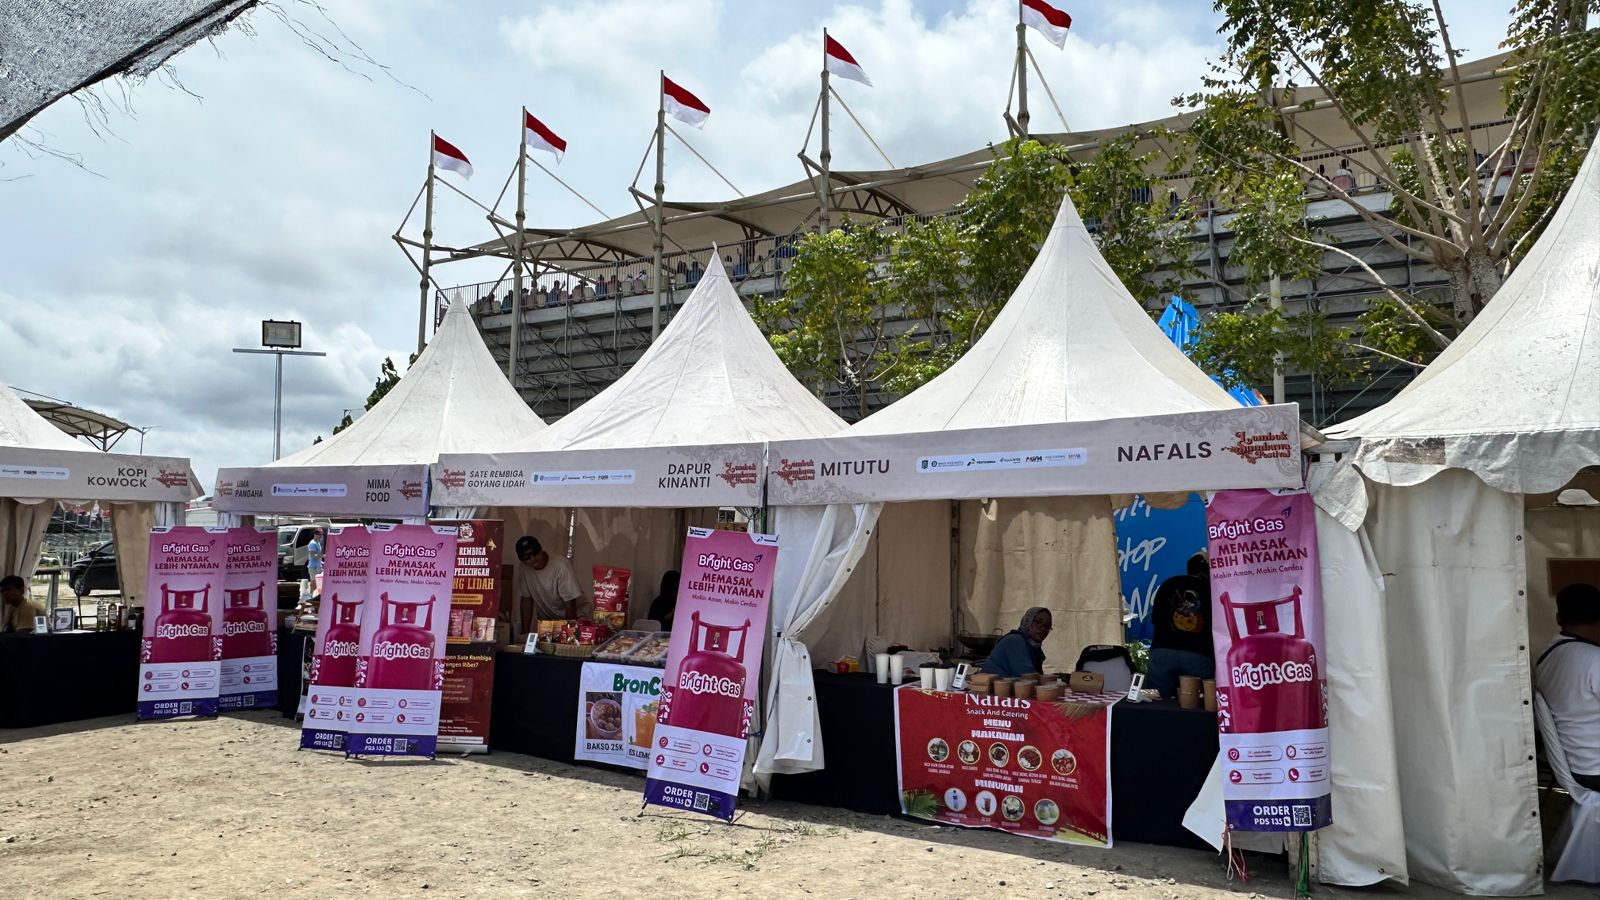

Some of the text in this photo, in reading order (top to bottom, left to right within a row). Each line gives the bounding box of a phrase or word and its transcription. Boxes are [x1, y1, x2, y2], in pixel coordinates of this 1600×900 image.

[1117, 441, 1212, 463] NAFALS
[118, 468, 147, 477] KOPI
[668, 463, 711, 475] DAPUR
[821, 459, 890, 476] MITUTU
[469, 470, 488, 478] SATE
[87, 476, 147, 487] KOWOCK
[367, 479, 390, 488] MIMA
[468, 480, 500, 488] GOYANG
[658, 476, 710, 488] KINANTI
[366, 492, 390, 502] FOOD
[1209, 519, 1284, 539] Bright Gas
[162, 542, 210, 554] Bright Gas
[244, 543, 260, 552] Gas
[336, 546, 356, 559] Bright
[384, 543, 437, 557] Bright Gas
[459, 547, 486, 556] REMBIGA
[1218, 537, 1289, 556] MEMASAK
[1243, 547, 1308, 564] NYAMAN
[234, 561, 272, 569] NYAMAN
[388, 560, 435, 569] MEMASAK
[698, 553, 754, 572] Bright Gas
[375, 567, 447, 578] LEBIH NYAMAN
[467, 578, 494, 590] LIDAH
[702, 572, 753, 587] MEMASAK
[688, 580, 764, 599] LEBIH NYAMAN
[157, 624, 209, 639] Bright Gas
[247, 621, 265, 631] Gas
[326, 640, 359, 658] Bright Ga
[374, 641, 431, 660] Bright Gas
[1232, 661, 1312, 690] Bright Gas
[613, 673, 662, 696] BronC
[680, 671, 740, 698] Bright Gas
[1002, 710, 1029, 719] Catering
[984, 719, 1012, 728] MENU
[365, 737, 392, 745] ORDER
[971, 730, 1025, 741] MAKANAN
[587, 743, 609, 751] BAKSO
[975, 779, 1023, 793] MINUMAN
[664, 786, 693, 799] ORDER
[1253, 805, 1290, 816] ORDER
